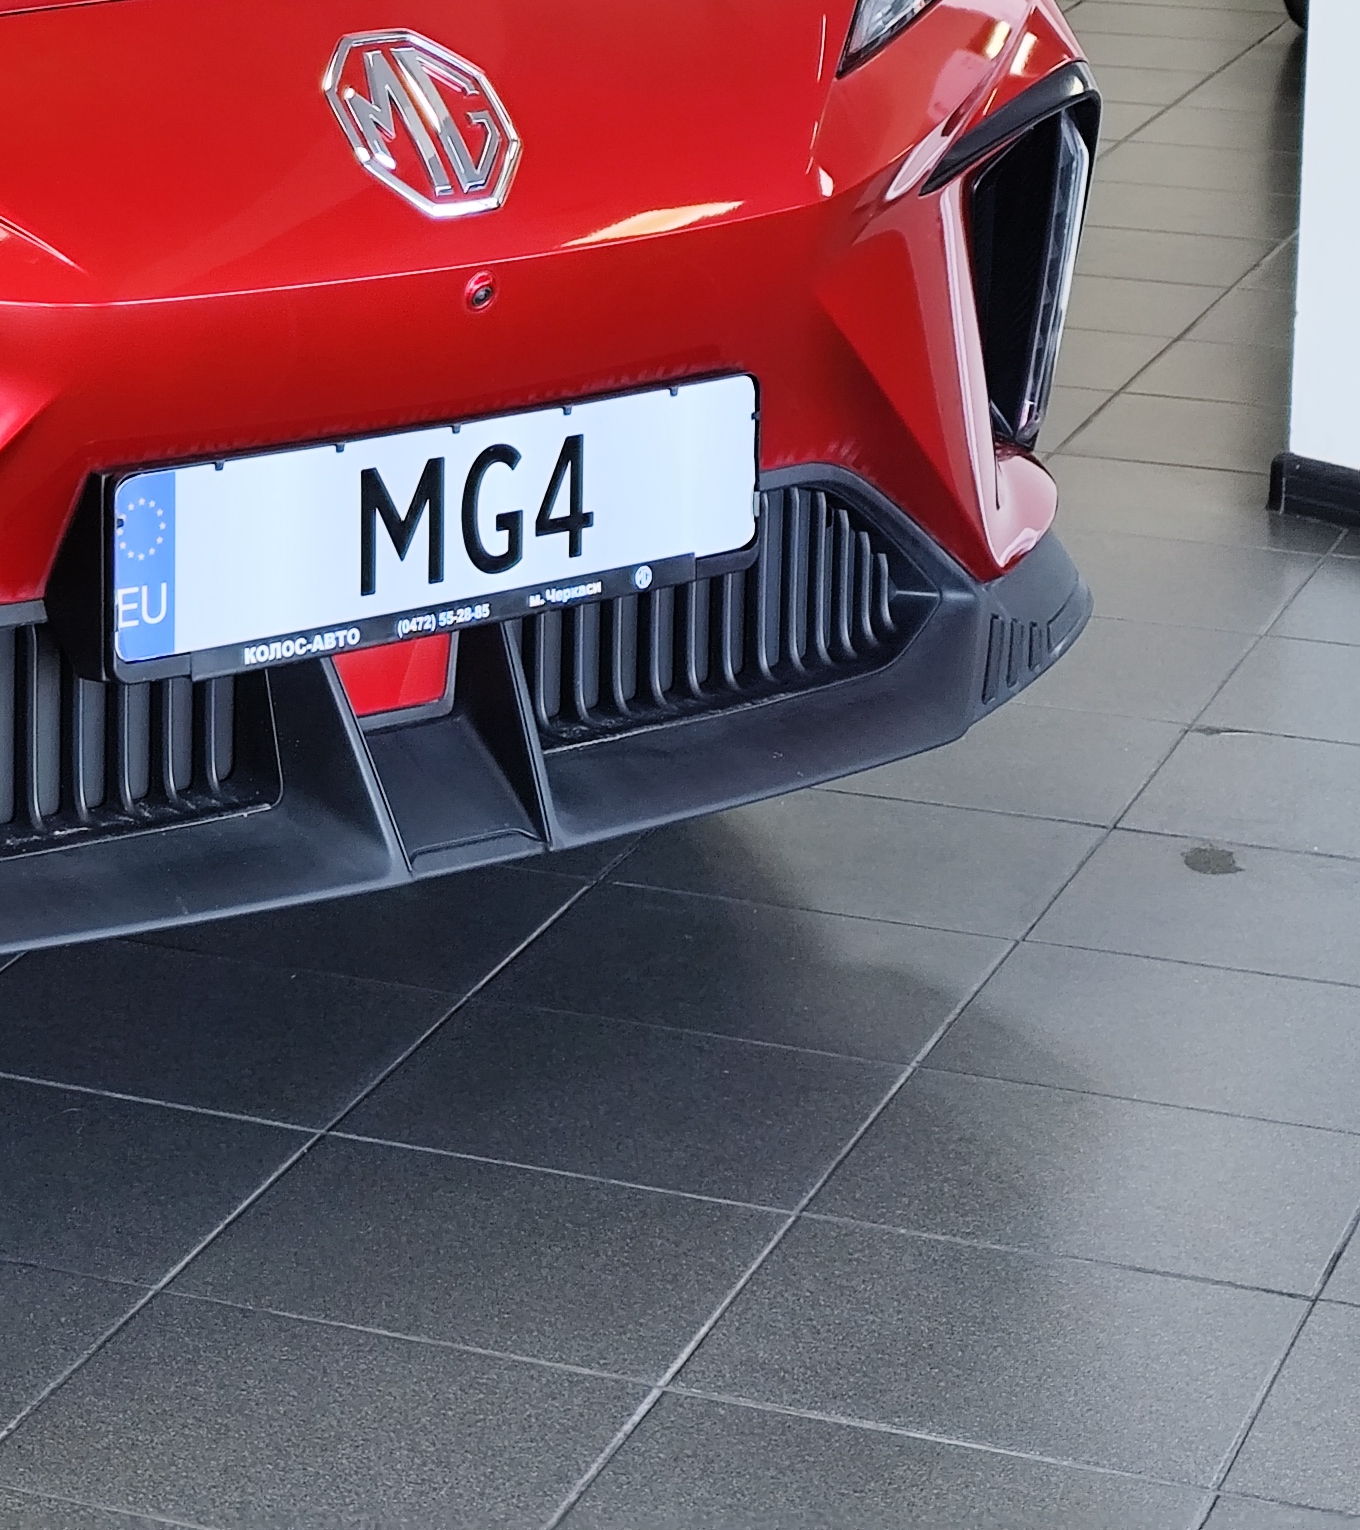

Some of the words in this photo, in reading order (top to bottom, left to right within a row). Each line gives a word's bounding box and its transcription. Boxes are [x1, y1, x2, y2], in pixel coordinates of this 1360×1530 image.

[341, 45, 501, 197] MG
[360, 433, 594, 596] MG4
[116, 581, 168, 628] EU
[244, 626, 362, 665] КОЛОС-АВТО
[397, 613, 437, 639] (0472)
[438, 603, 491, 627] 55-28-85
[545, 580, 602, 603] Черкаси
